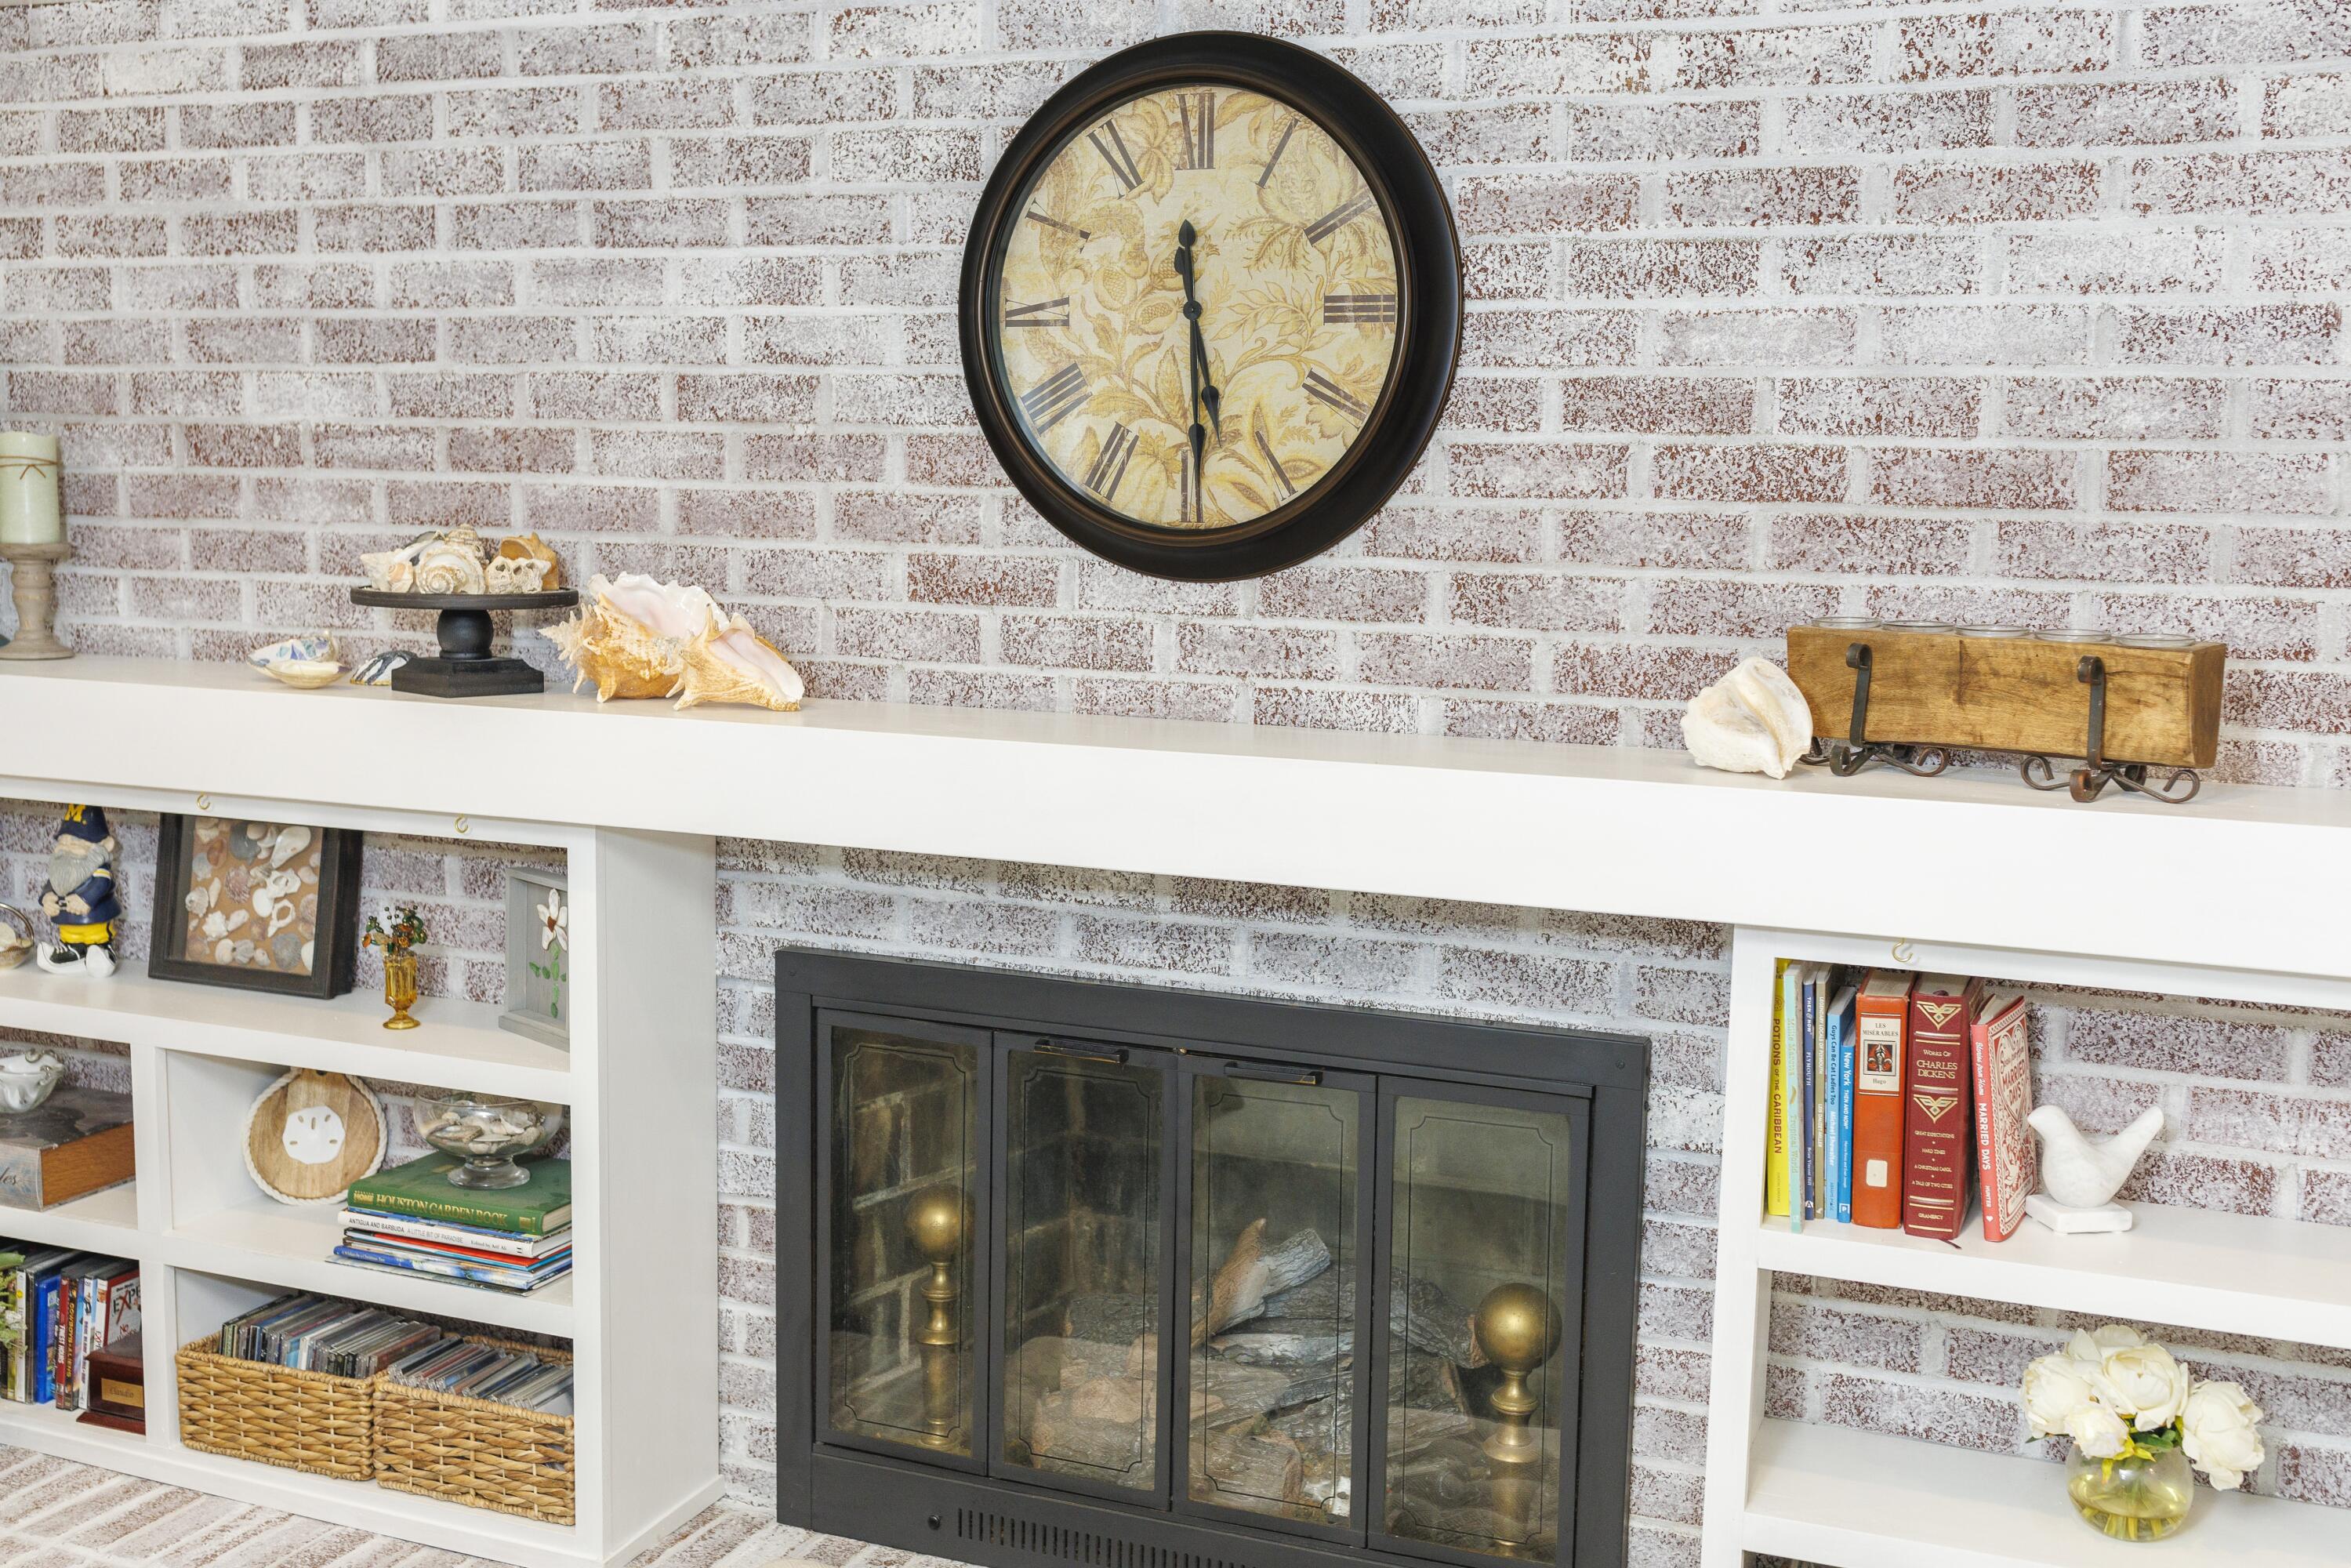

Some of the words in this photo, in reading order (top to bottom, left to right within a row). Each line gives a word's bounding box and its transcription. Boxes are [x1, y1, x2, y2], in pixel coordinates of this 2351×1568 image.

[1175, 92, 1217, 170] XII
[1087, 118, 1145, 199] XI
[1255, 116, 1301, 189] I
[1303, 187, 1374, 247] II
[1005, 295, 1069, 329] IX
[1324, 292, 1395, 325] III
[1019, 361, 1092, 437] VIII
[1301, 368, 1370, 431] IV
[1083, 421, 1139, 503] VII
[1255, 430, 1298, 501] V
[1774, 1069, 1780, 1077] OF
[1843, 1070, 1852, 1086] York
[1917, 1059, 1958, 1070] CHARLES
[1917, 1069, 1956, 1079] DICKENS
[1975, 1063, 1984, 1078] from
[2002, 1059, 2025, 1091] MARRIED
[1978, 1102, 1990, 1146] MARRIED
[1981, 1149, 1991, 1171] DAYS
[349, 1218, 369, 1227] ANTIGUA
[381, 1223, 405, 1233] BARBUDA
[376, 1194, 429, 1214] HOUSTON
[430, 1202, 474, 1223] GARDEN
[476, 1209, 508, 1228] BOOK
[441, 1234, 463, 1243] PARADISE
